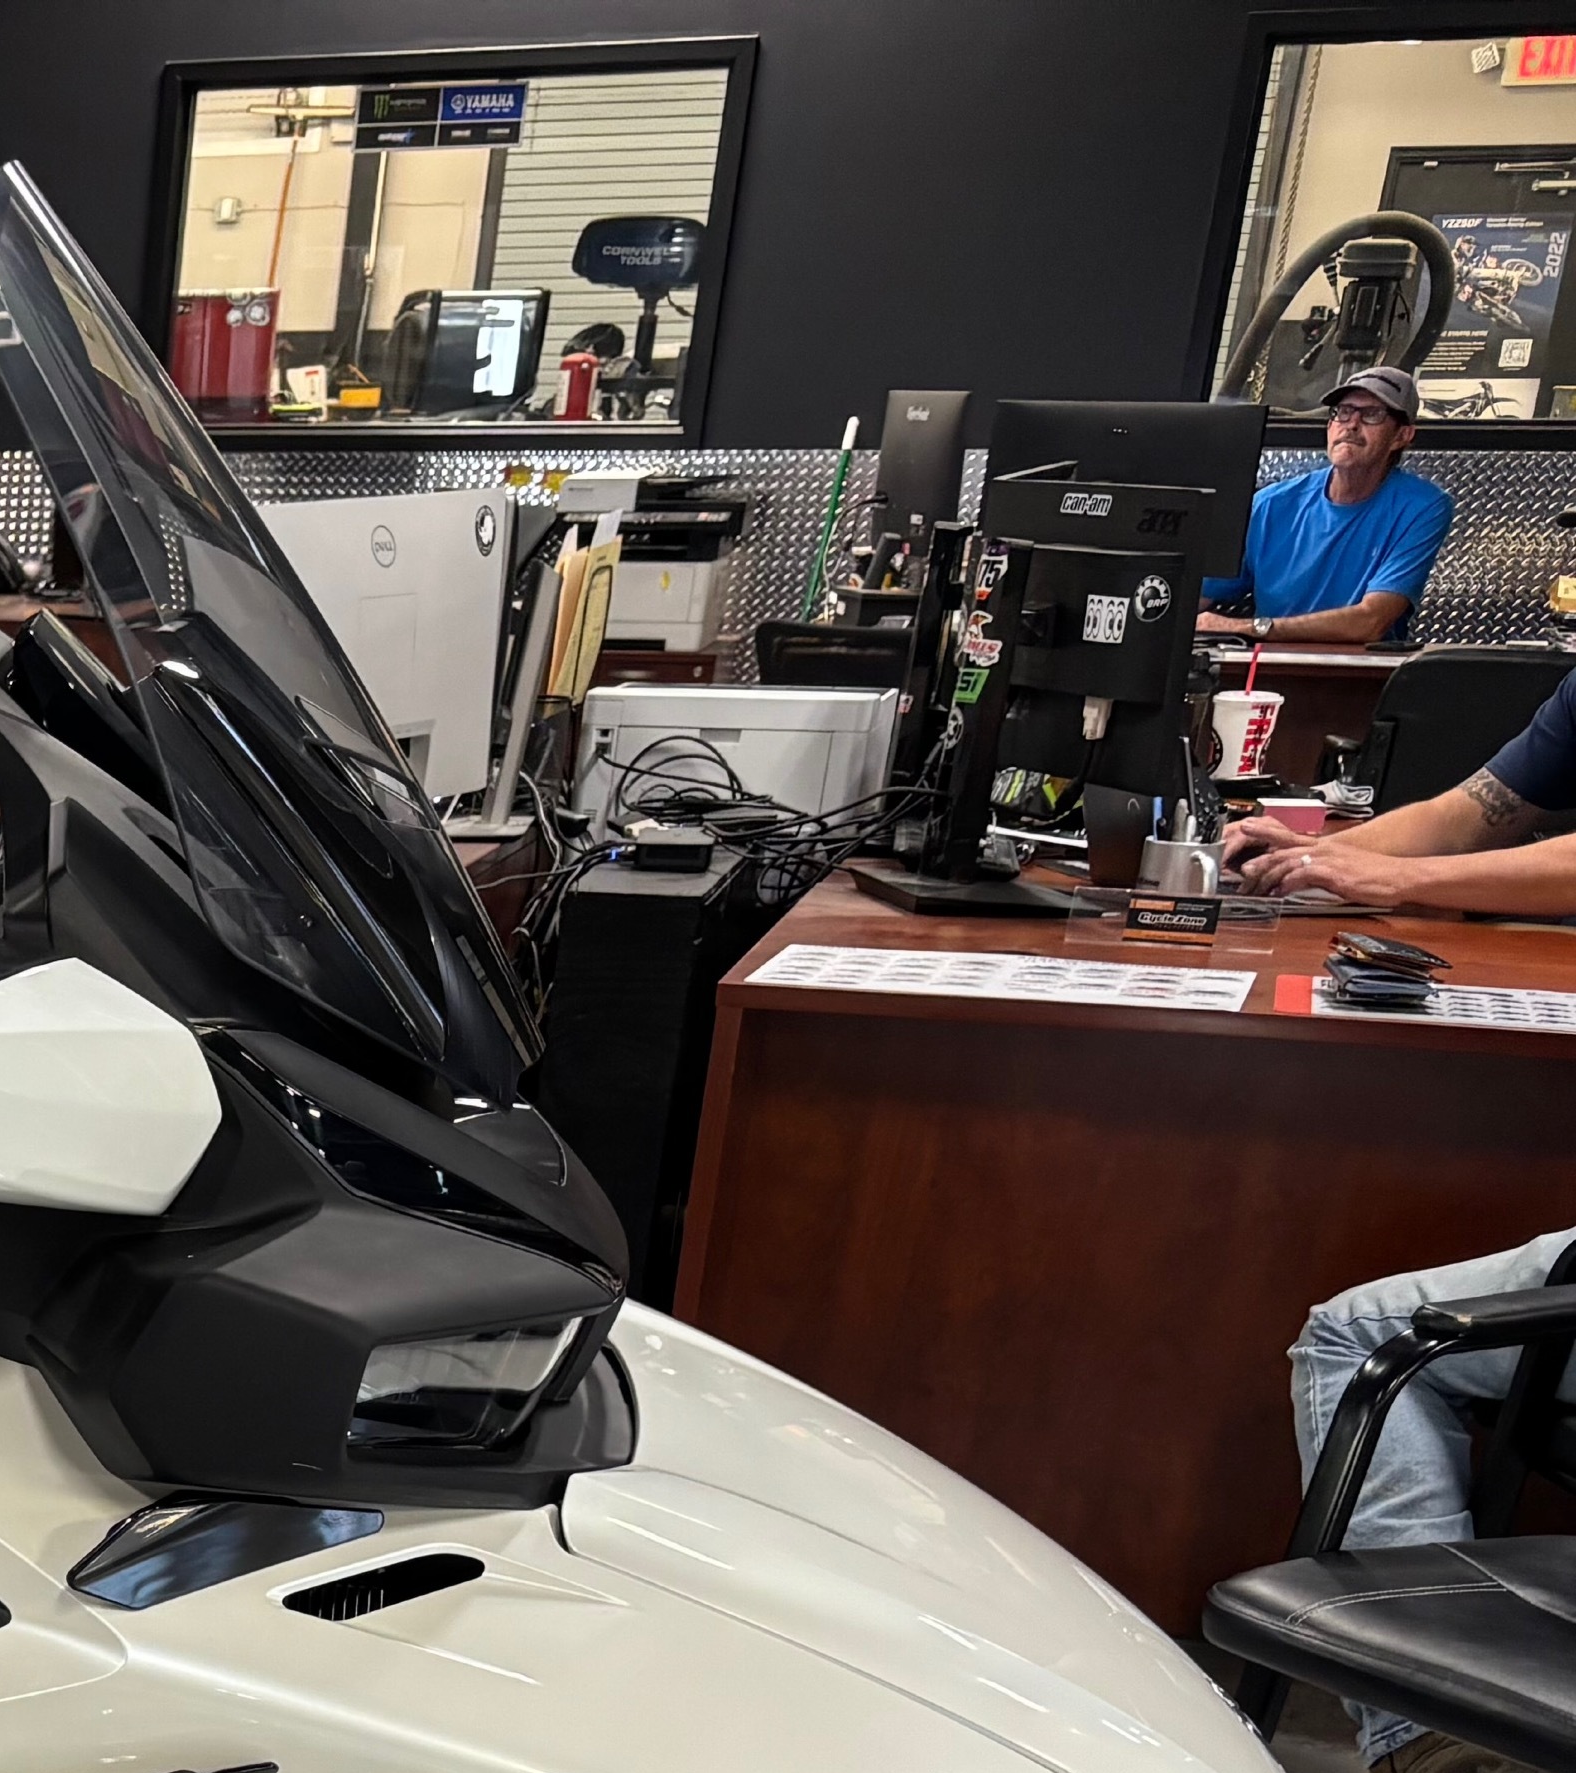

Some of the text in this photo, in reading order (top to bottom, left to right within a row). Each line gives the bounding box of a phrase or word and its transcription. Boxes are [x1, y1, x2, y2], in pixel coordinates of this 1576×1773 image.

[466, 93, 515, 108] YAMAHA
[602, 246, 678, 256] CORNWEL
[1543, 232, 1567, 278] 2022
[620, 256, 662, 265] TOOLS
[1062, 495, 1111, 514] can-am
[1147, 599, 1169, 608] BRP
[1139, 912, 1207, 926] Cycle Zone
